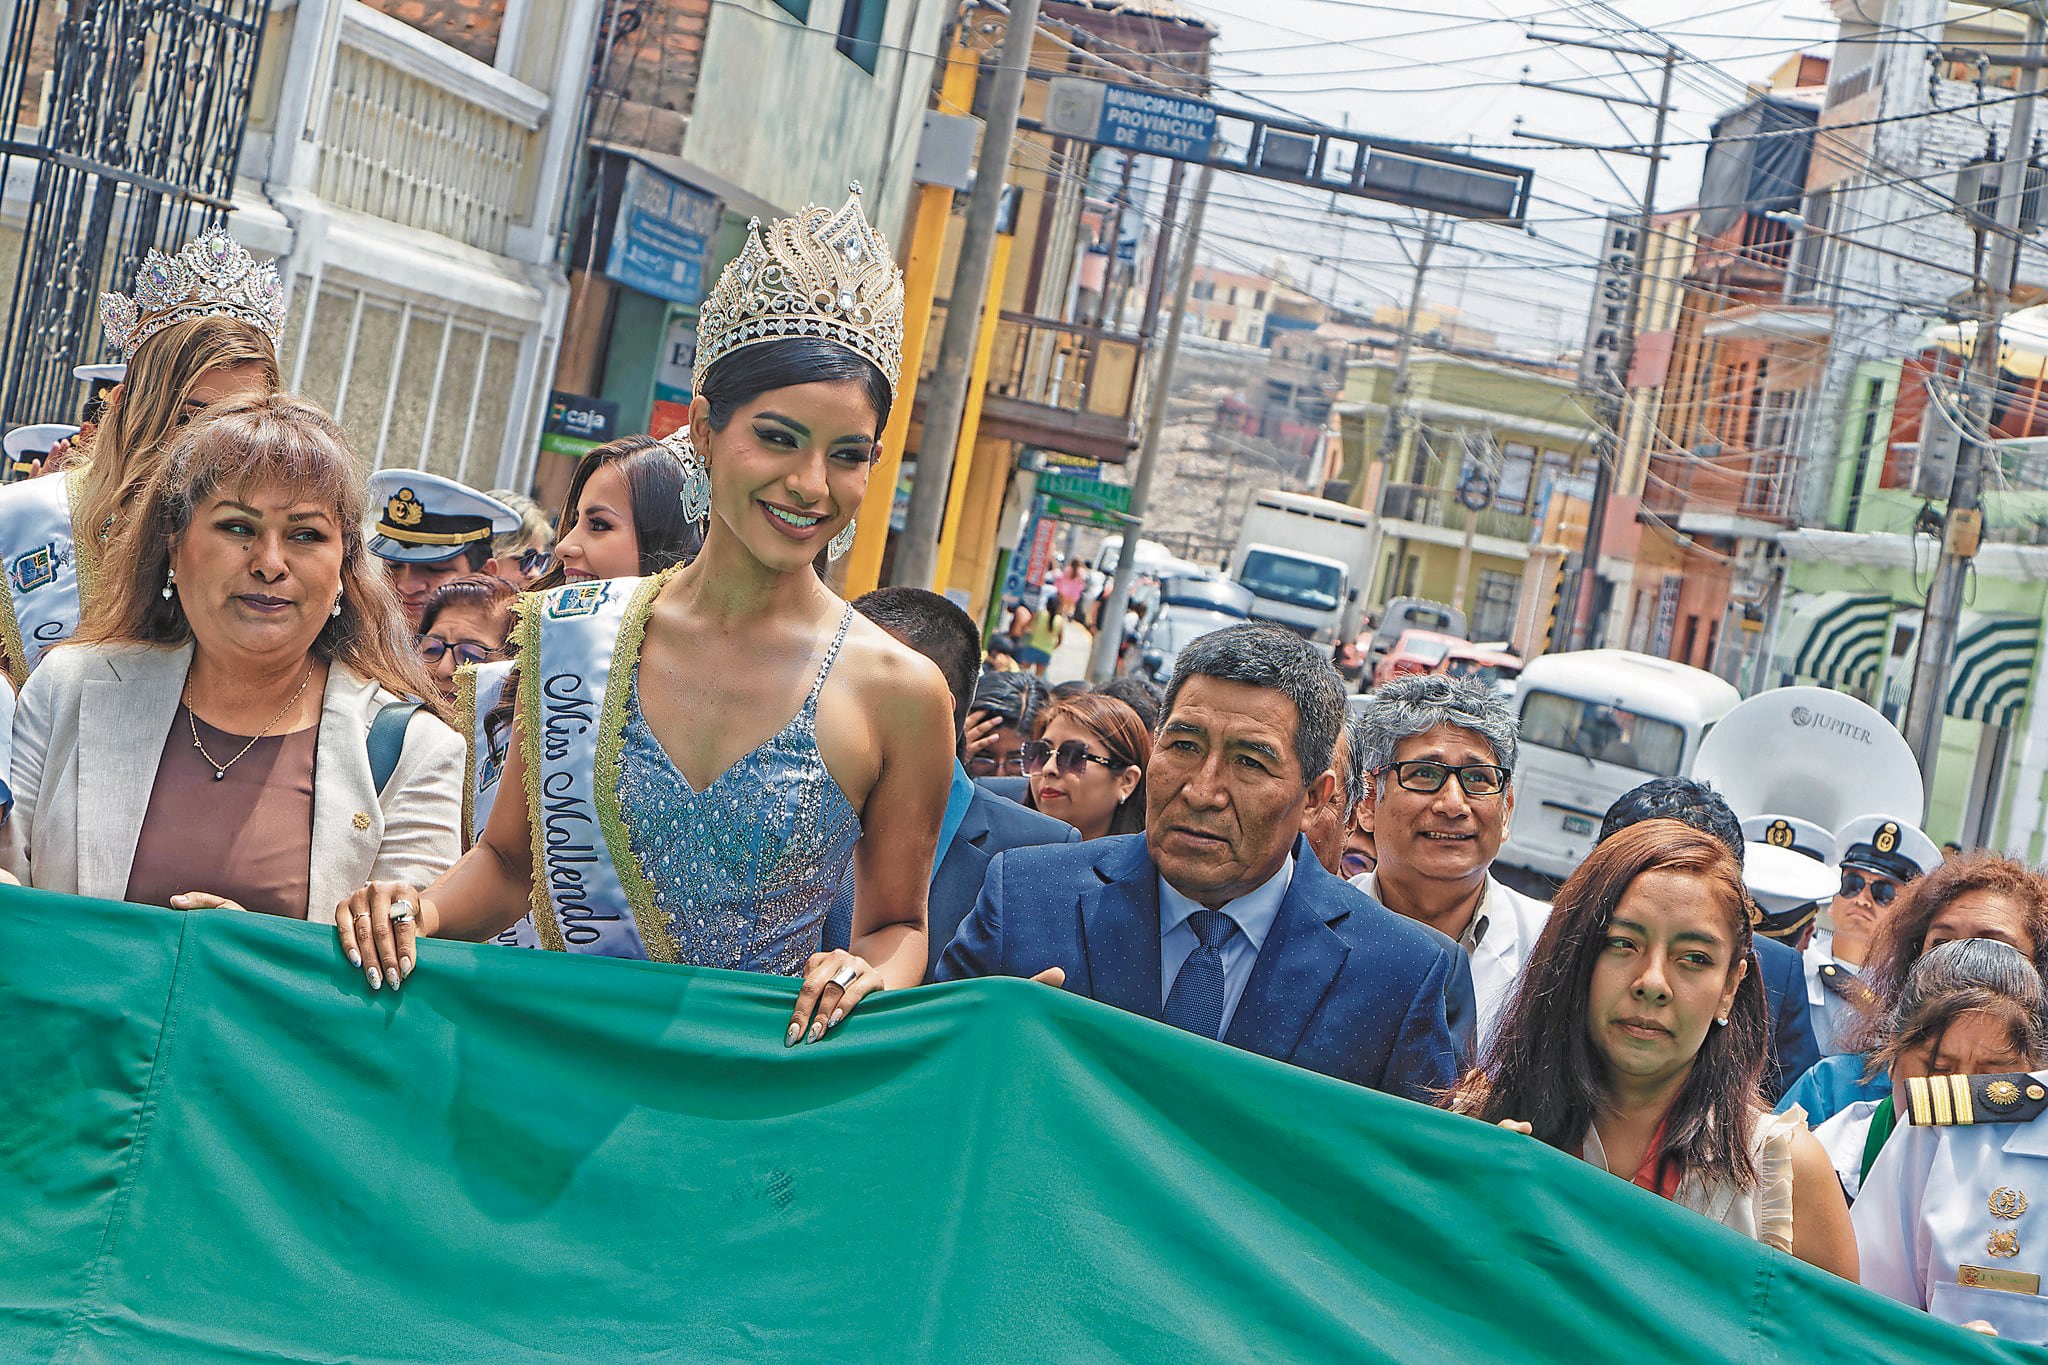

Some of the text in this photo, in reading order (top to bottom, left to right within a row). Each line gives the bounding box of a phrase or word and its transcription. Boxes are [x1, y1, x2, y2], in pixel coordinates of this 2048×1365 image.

[1108, 88, 1215, 124] MUNICIPALIDAD
[1107, 107, 1206, 140] PROVINCIAL
[1115, 126, 1192, 153] DE ISLAY
[567, 409, 605, 428] caja
[1812, 712, 1873, 745] JUPITER
[543, 673, 620, 945] Miss Mollendo
